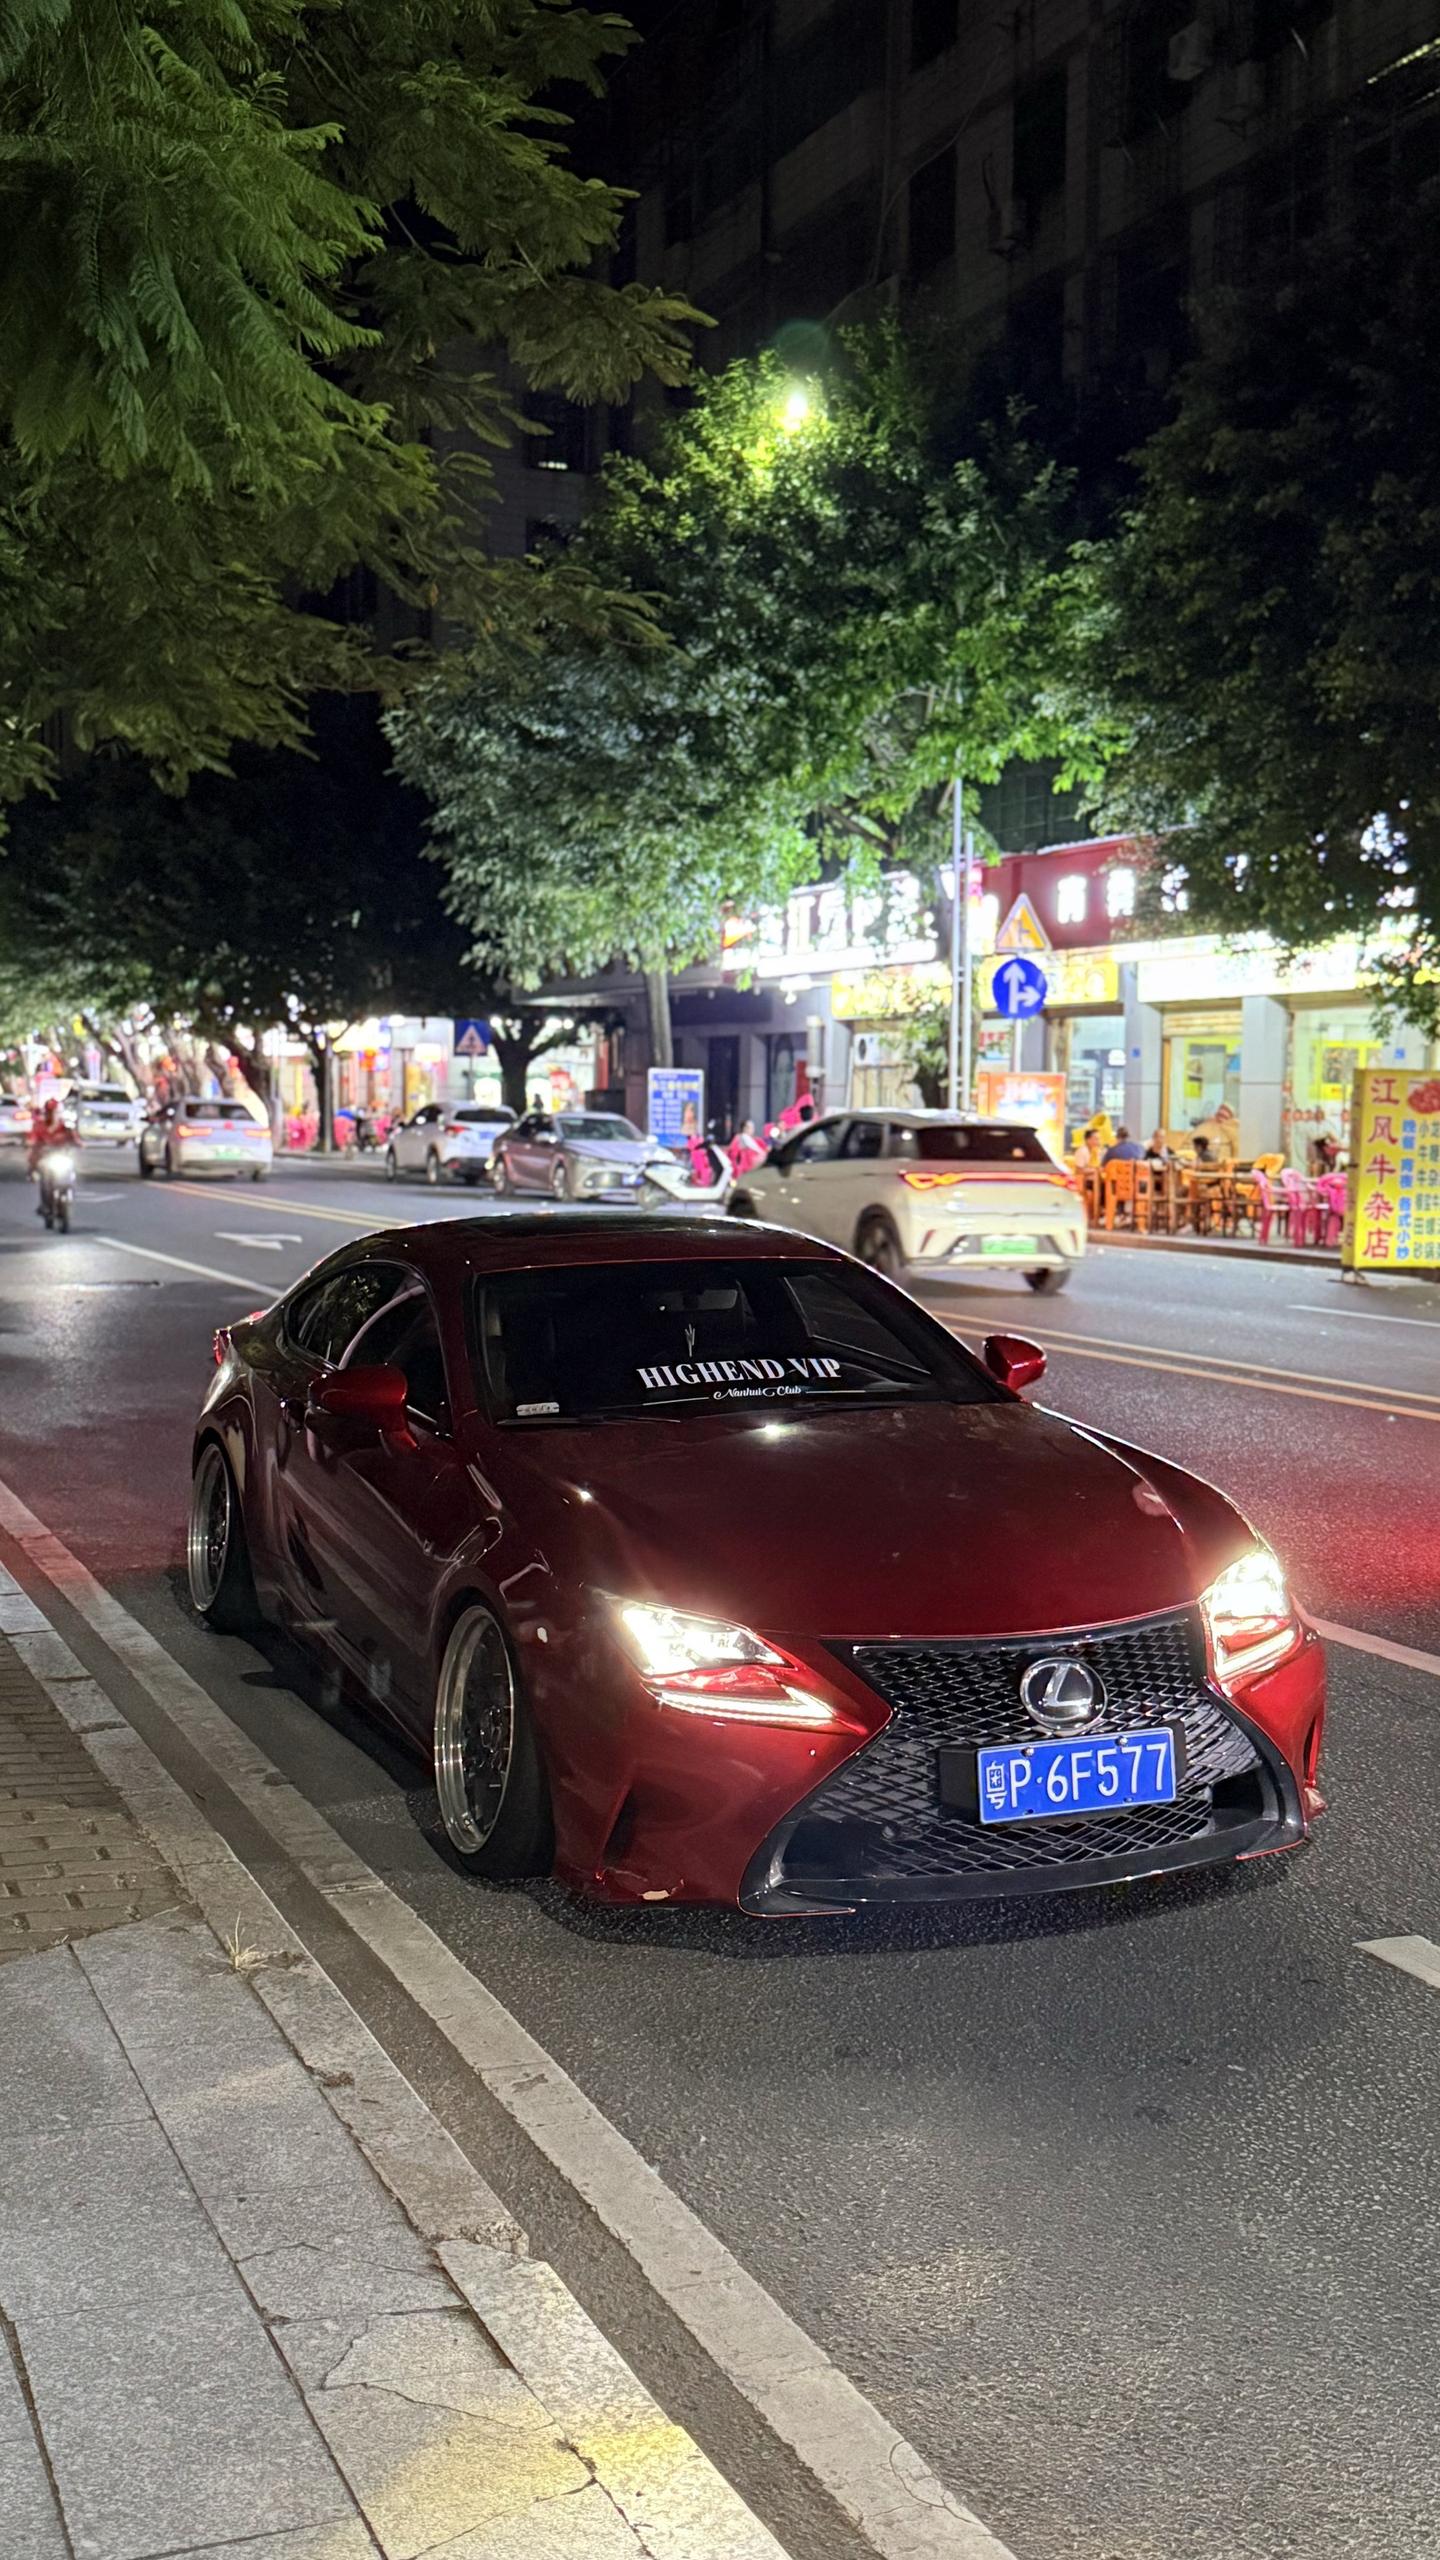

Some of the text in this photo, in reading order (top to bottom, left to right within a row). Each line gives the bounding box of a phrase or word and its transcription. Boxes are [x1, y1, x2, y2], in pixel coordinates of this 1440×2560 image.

[1362, 1078, 1400, 1259] 江风牛杂店
[635, 1357, 842, 1389] HIGHEND VIP
[772, 1385, 802, 1397] Club
